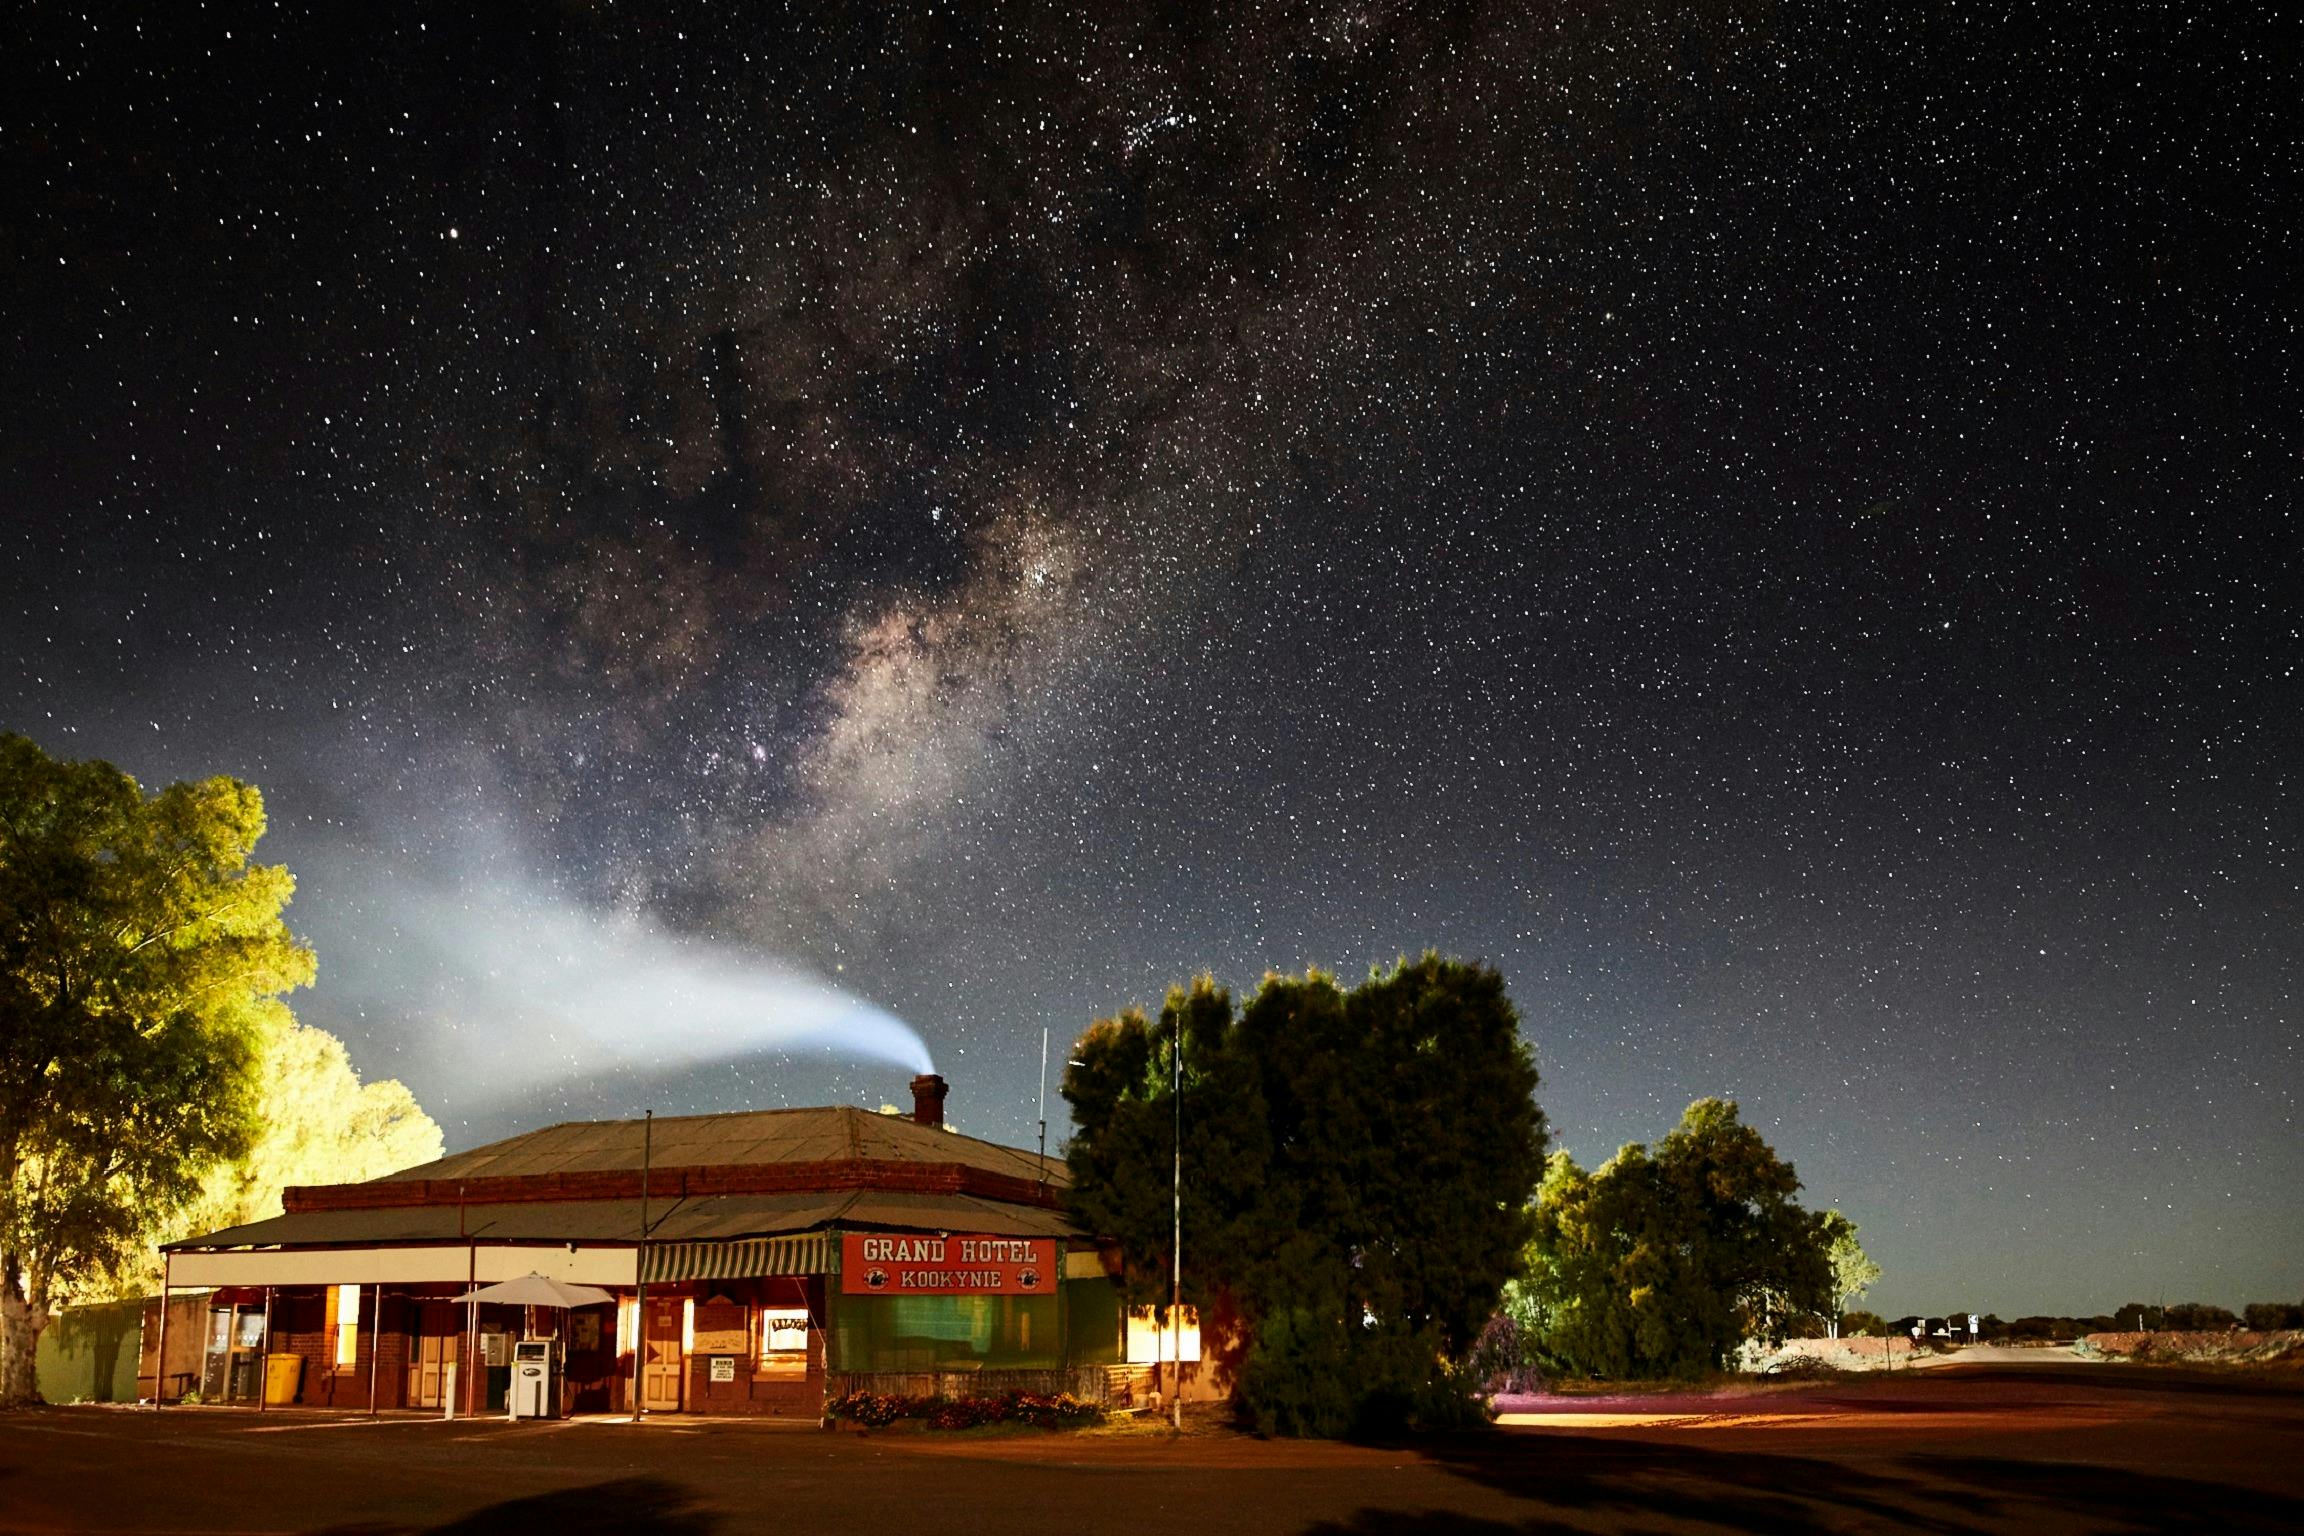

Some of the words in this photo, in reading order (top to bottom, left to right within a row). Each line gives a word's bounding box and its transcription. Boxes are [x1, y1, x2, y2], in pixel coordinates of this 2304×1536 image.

[864, 1239, 945, 1262] GRAND
[961, 1241, 1037, 1263] HOTEL
[901, 1271, 1001, 1288] KOOKYNIE
